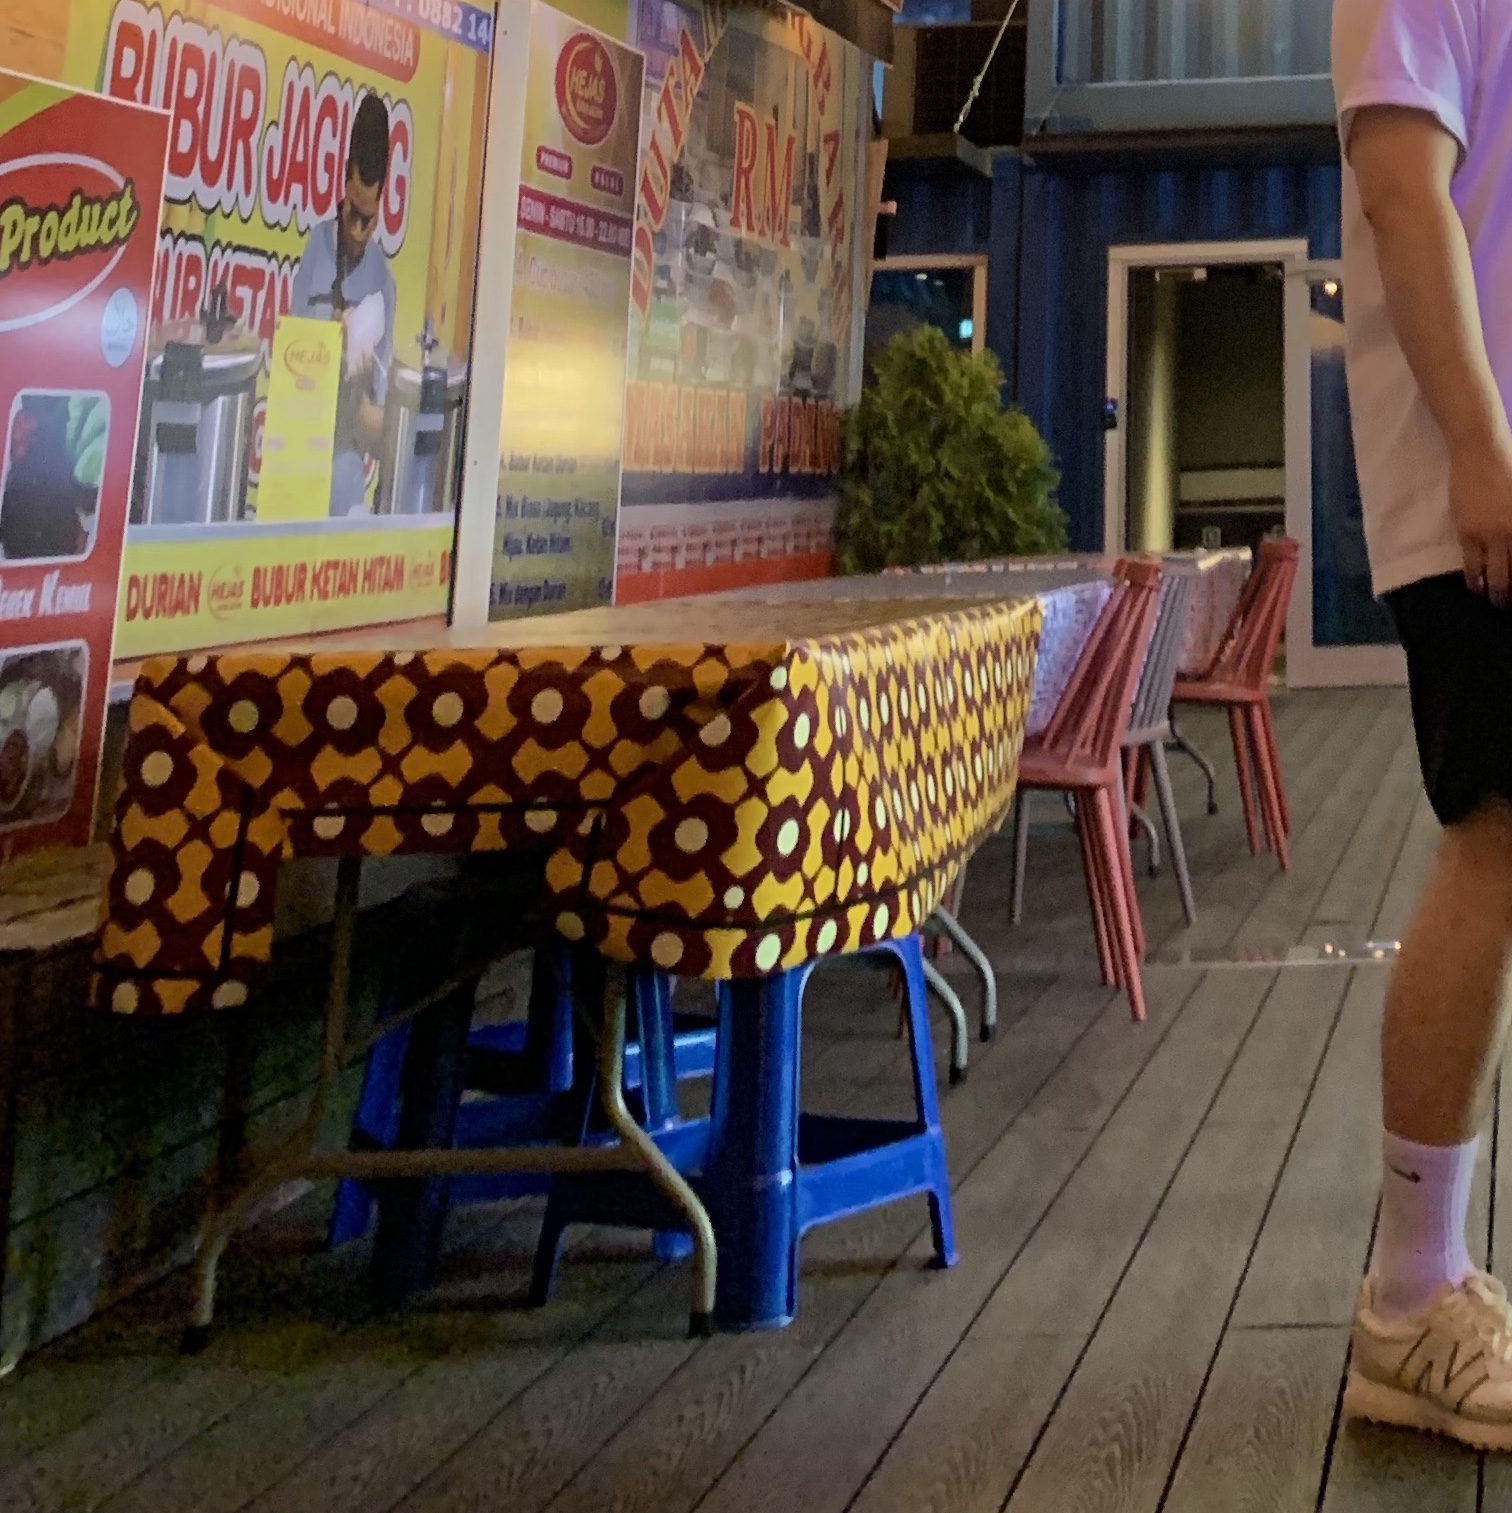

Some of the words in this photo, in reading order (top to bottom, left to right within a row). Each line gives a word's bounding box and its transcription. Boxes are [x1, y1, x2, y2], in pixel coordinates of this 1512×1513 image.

[265, 79, 409, 236] JAGG
[0, 183, 138, 273] Product
[125, 570, 203, 622] DURIAN
[250, 561, 308, 610] BUBUR
[309, 556, 361, 602] KETAN
[361, 553, 406, 596] HITAM
